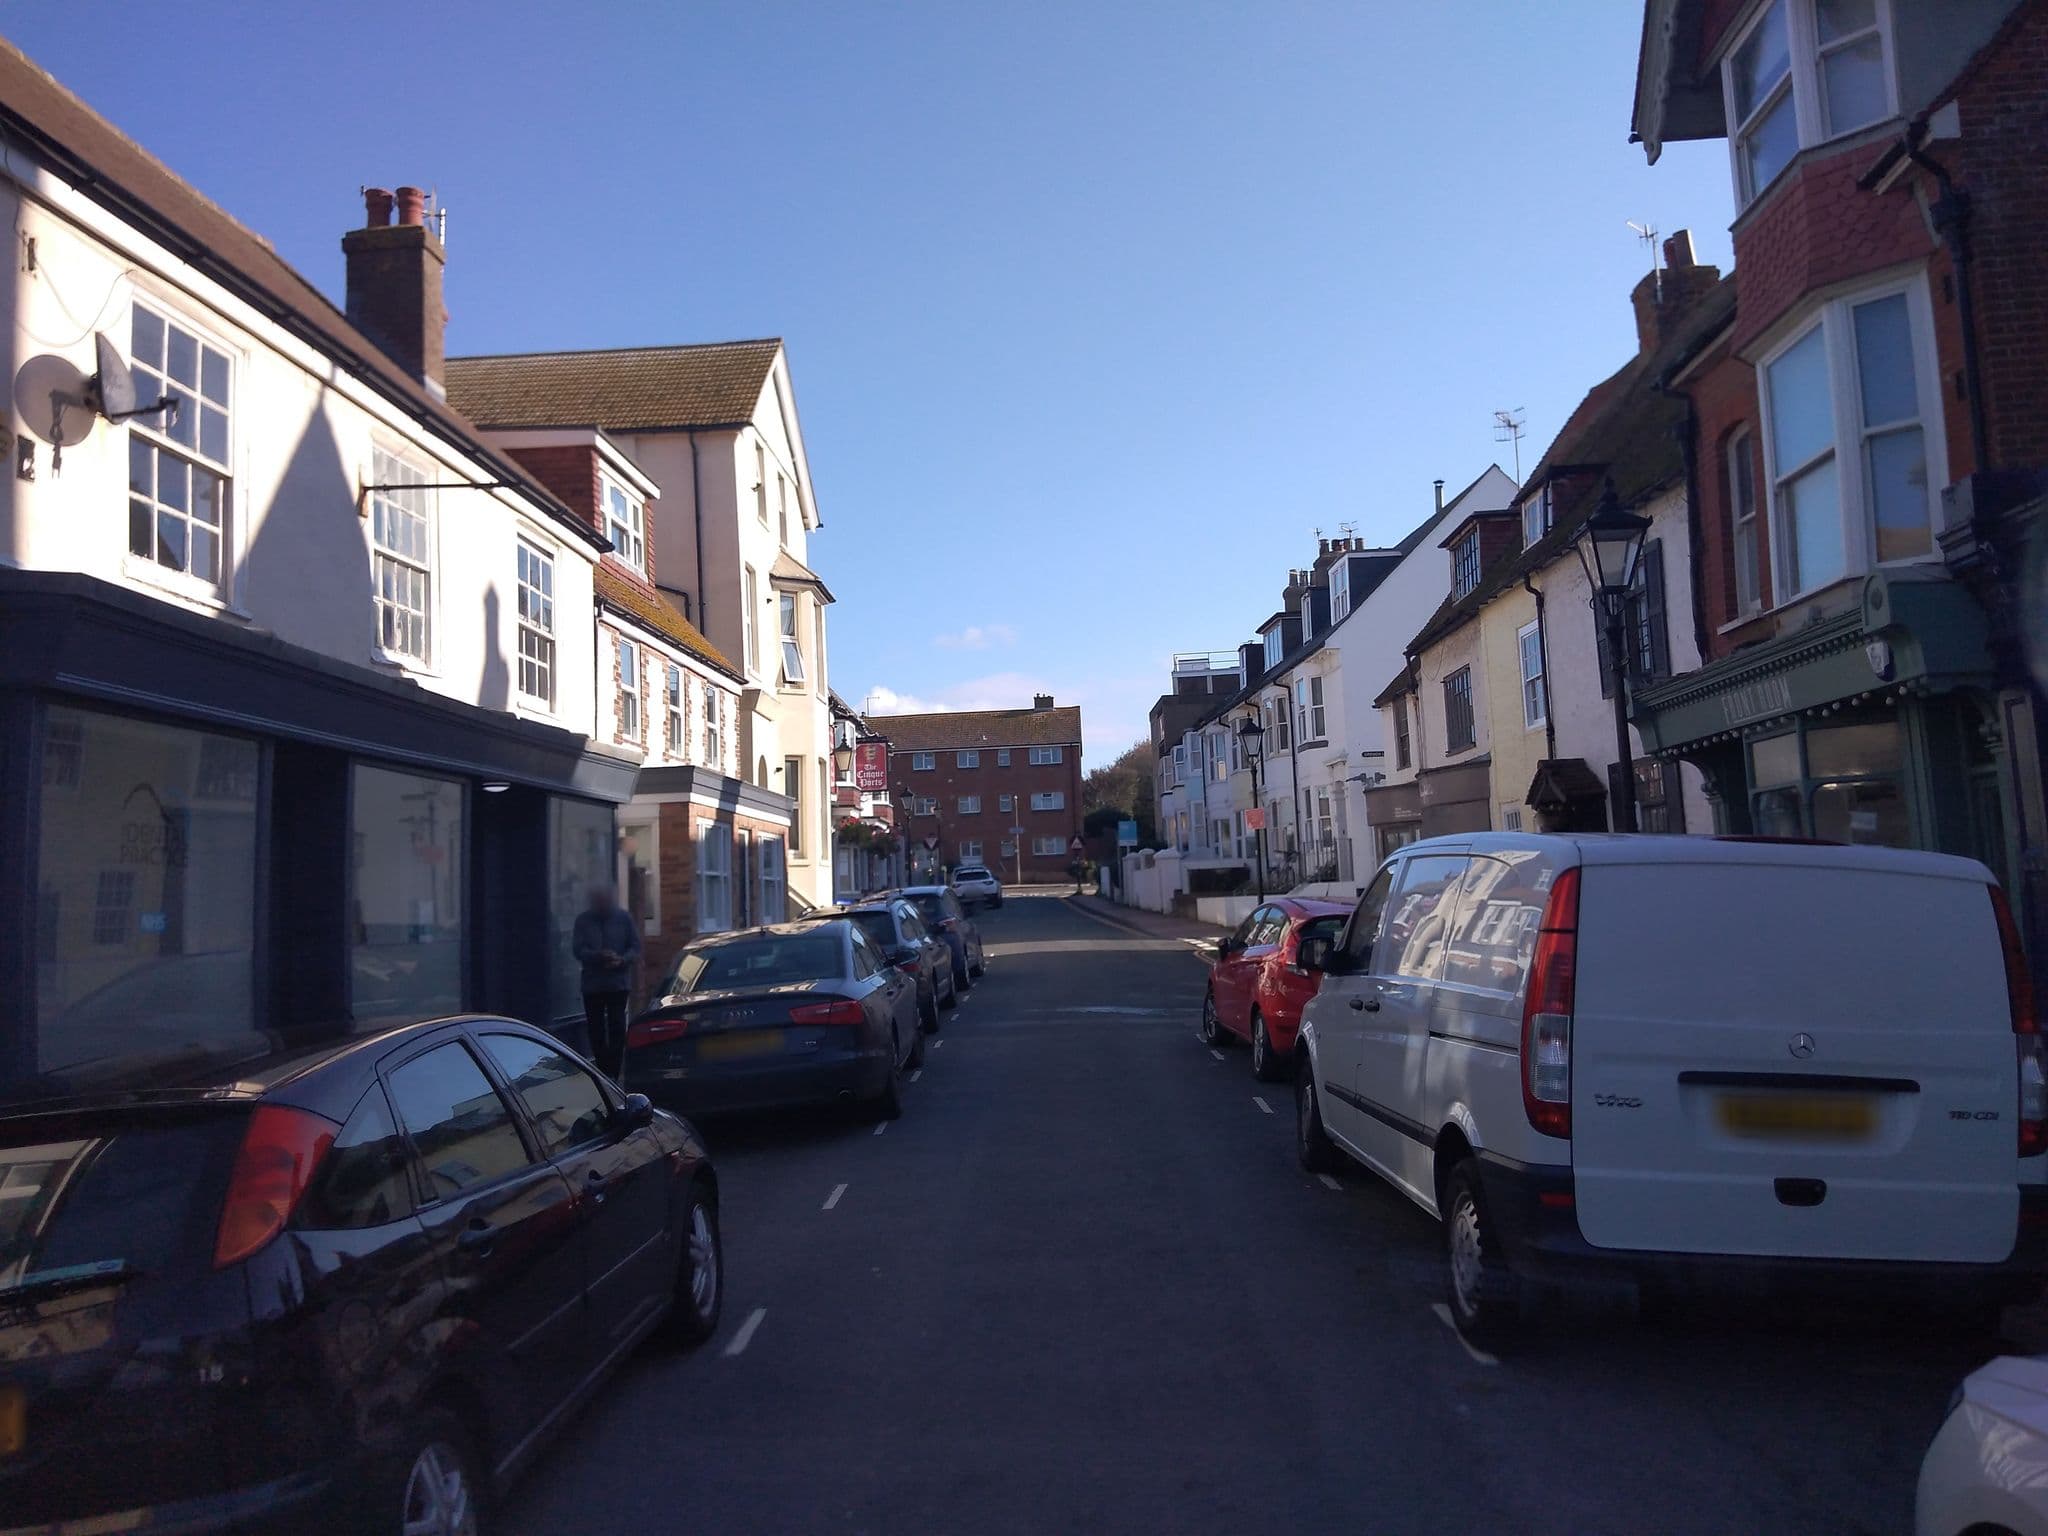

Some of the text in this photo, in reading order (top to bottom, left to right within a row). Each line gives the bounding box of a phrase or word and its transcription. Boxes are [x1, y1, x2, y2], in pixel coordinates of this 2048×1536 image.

[1720, 686, 1756, 725] FRONT
[863, 763, 878, 771] The
[857, 770, 885, 779] Cinque
[860, 778, 883, 788] Ports
